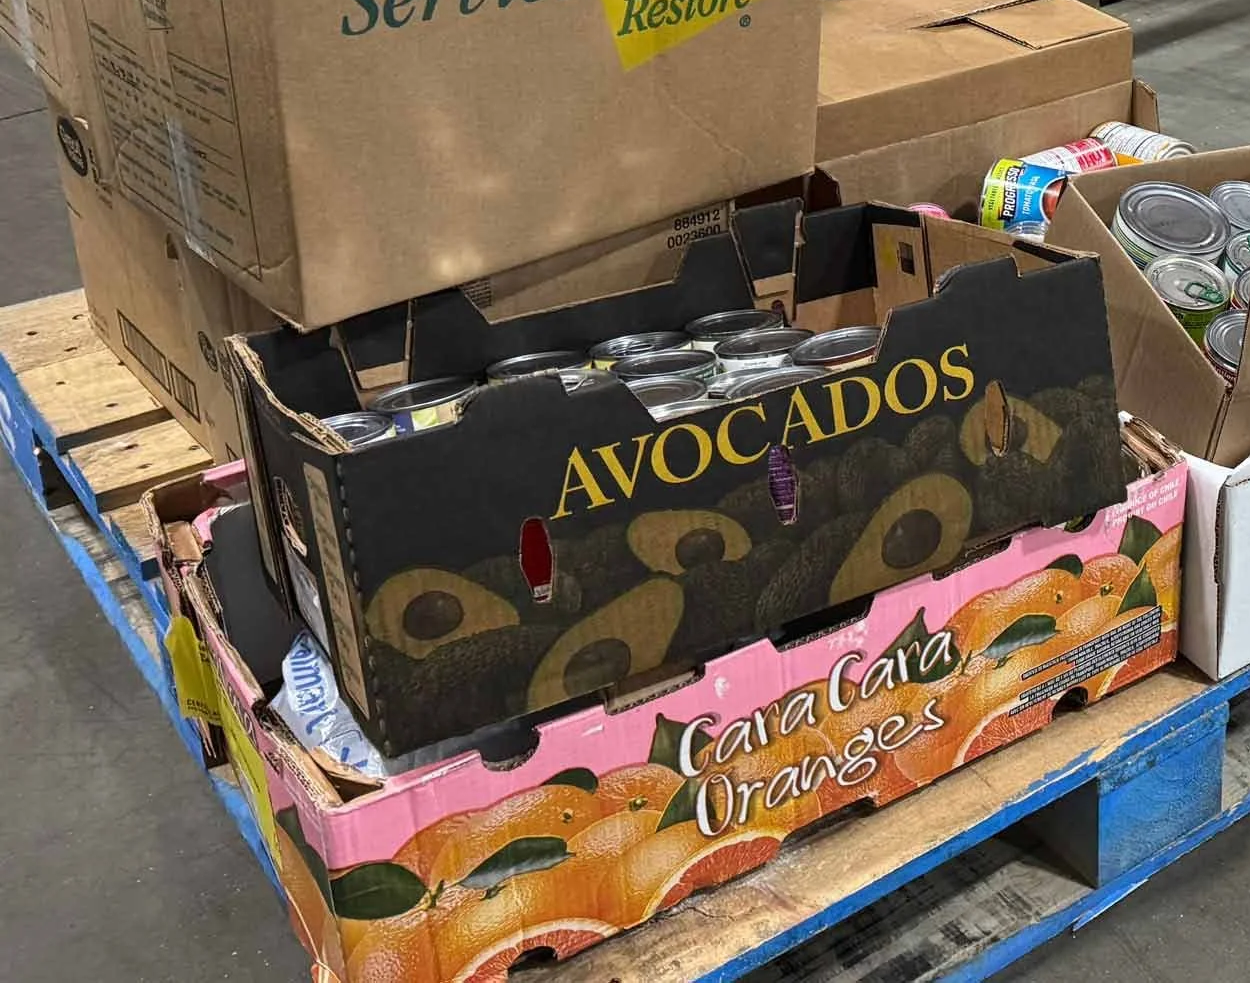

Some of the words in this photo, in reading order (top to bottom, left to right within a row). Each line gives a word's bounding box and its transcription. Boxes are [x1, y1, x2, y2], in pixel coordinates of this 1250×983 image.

[674, 209, 720, 231] 884912
[1002, 167, 1020, 219] PROGRESSO
[550, 343, 975, 520] AVOCADOS
[679, 691, 816, 778] Cara
[827, 630, 953, 712] Cara
[696, 698, 945, 837] Oranges
